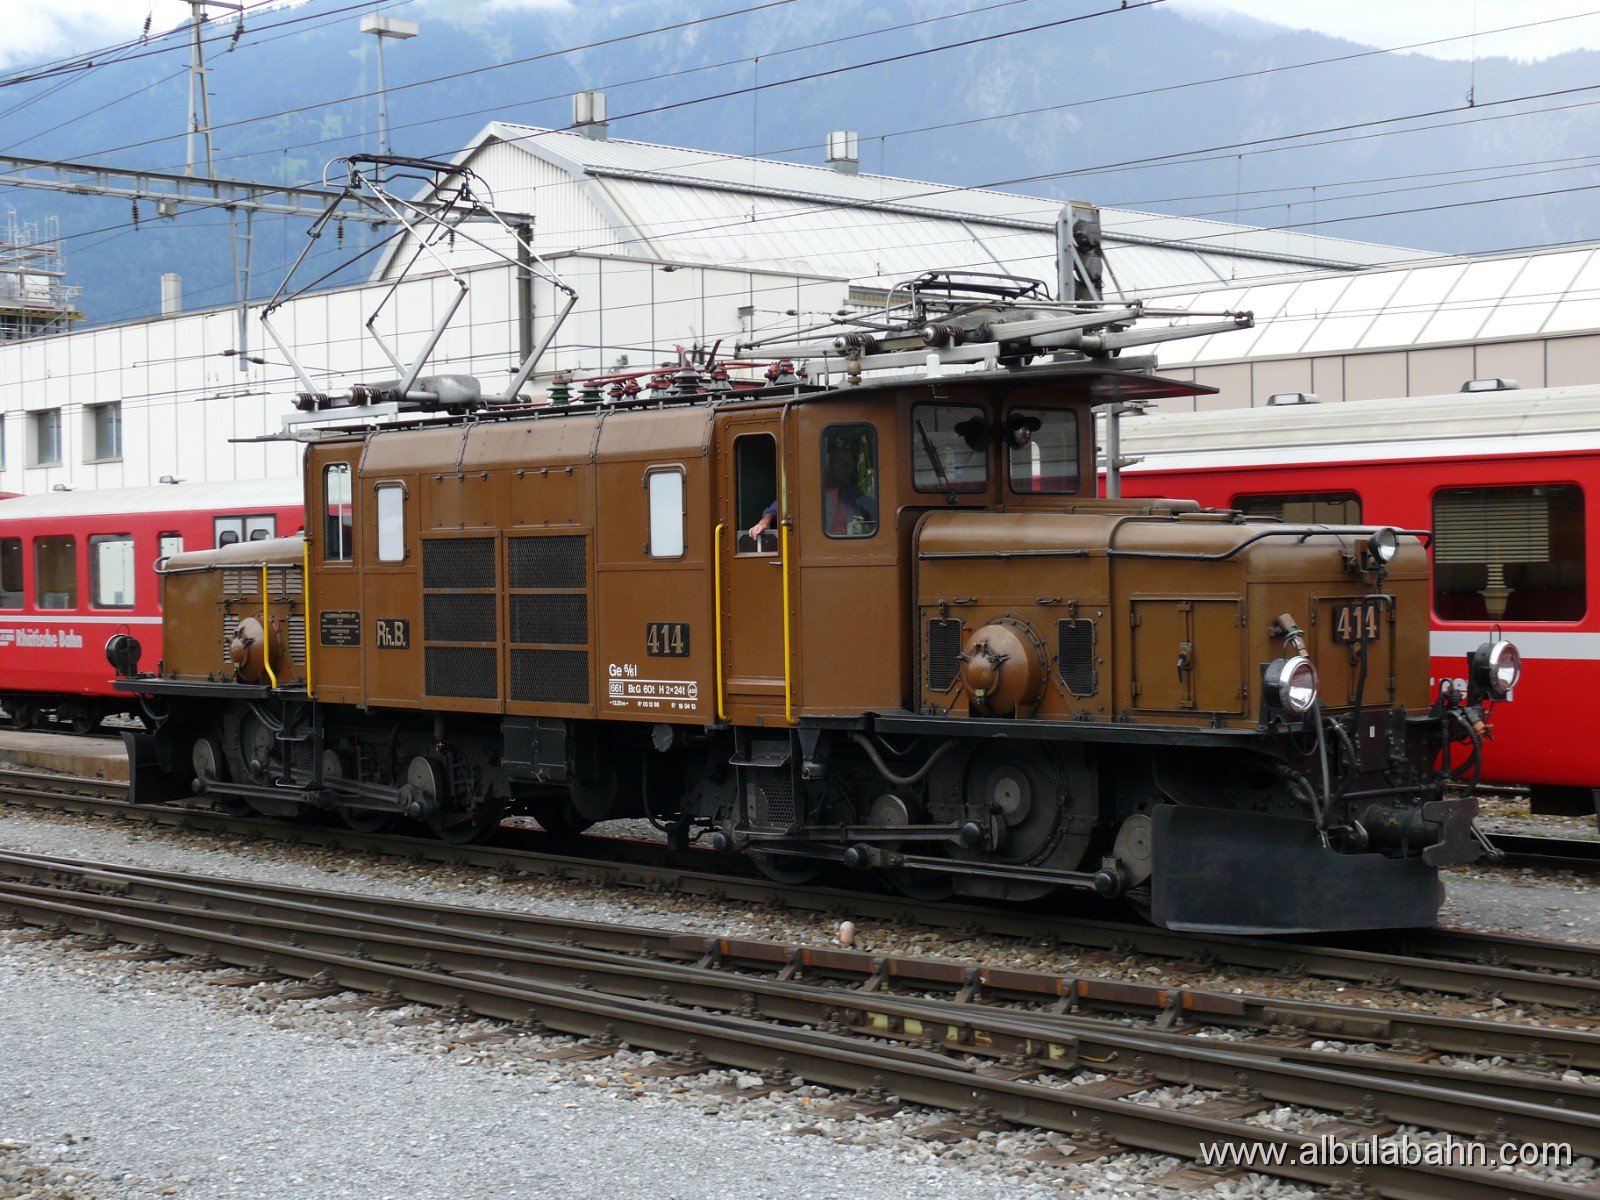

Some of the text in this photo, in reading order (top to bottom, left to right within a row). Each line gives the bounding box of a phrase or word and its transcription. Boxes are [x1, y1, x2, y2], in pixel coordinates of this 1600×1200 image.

[1337, 606, 1377, 640] 414
[58, 629, 83, 648] Bahn
[647, 624, 684, 654] 414
[608, 663, 623, 677] Ge
[643, 684, 655, 694] 60t
[658, 685, 665, 695] H
